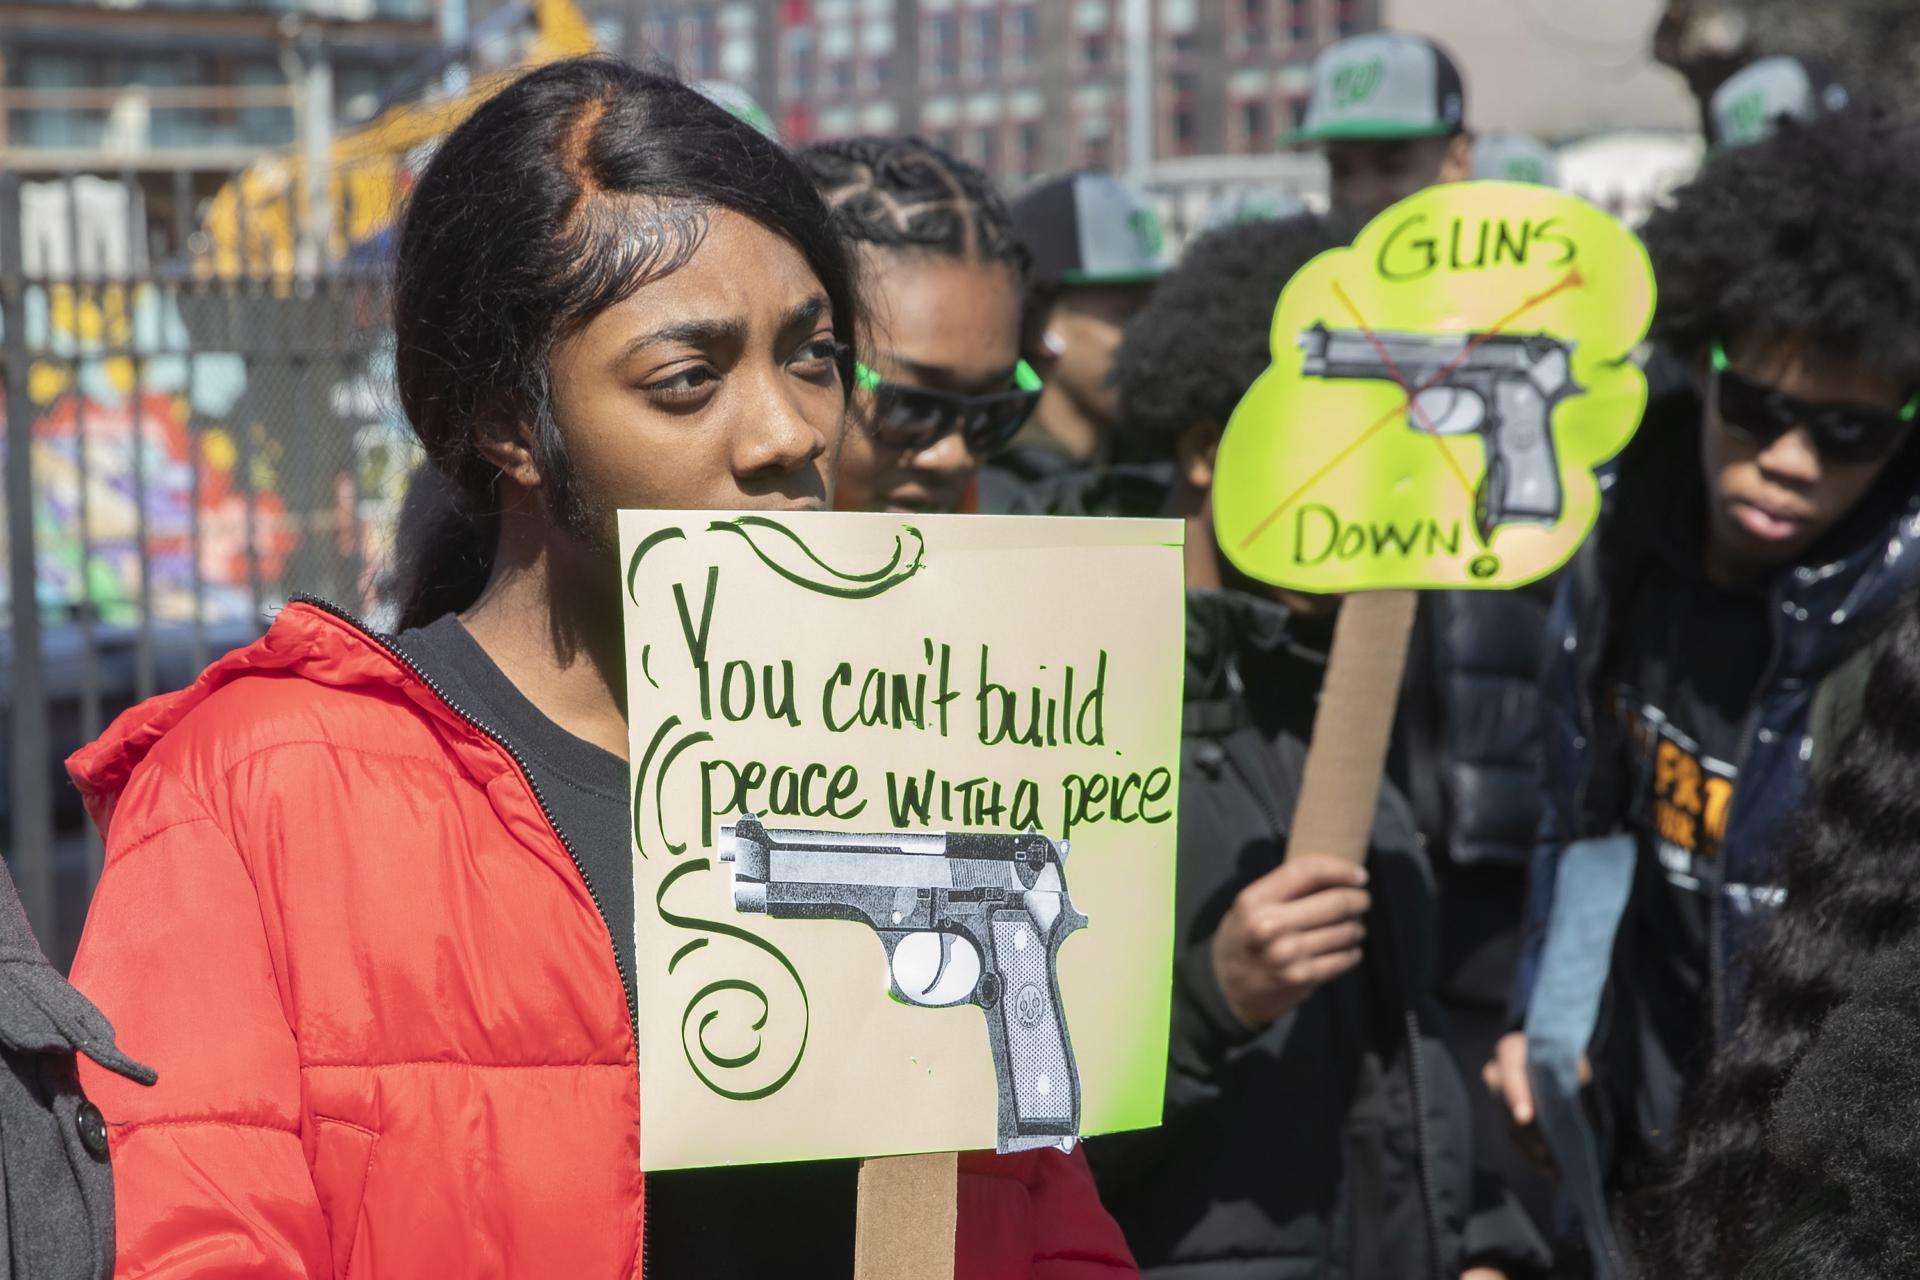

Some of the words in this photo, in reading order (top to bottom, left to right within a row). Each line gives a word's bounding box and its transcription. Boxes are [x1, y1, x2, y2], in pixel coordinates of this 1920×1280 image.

[1376, 213, 1578, 282] GUNS
[672, 566, 801, 728] You
[975, 643, 1107, 748] build
[700, 759, 869, 848] peace
